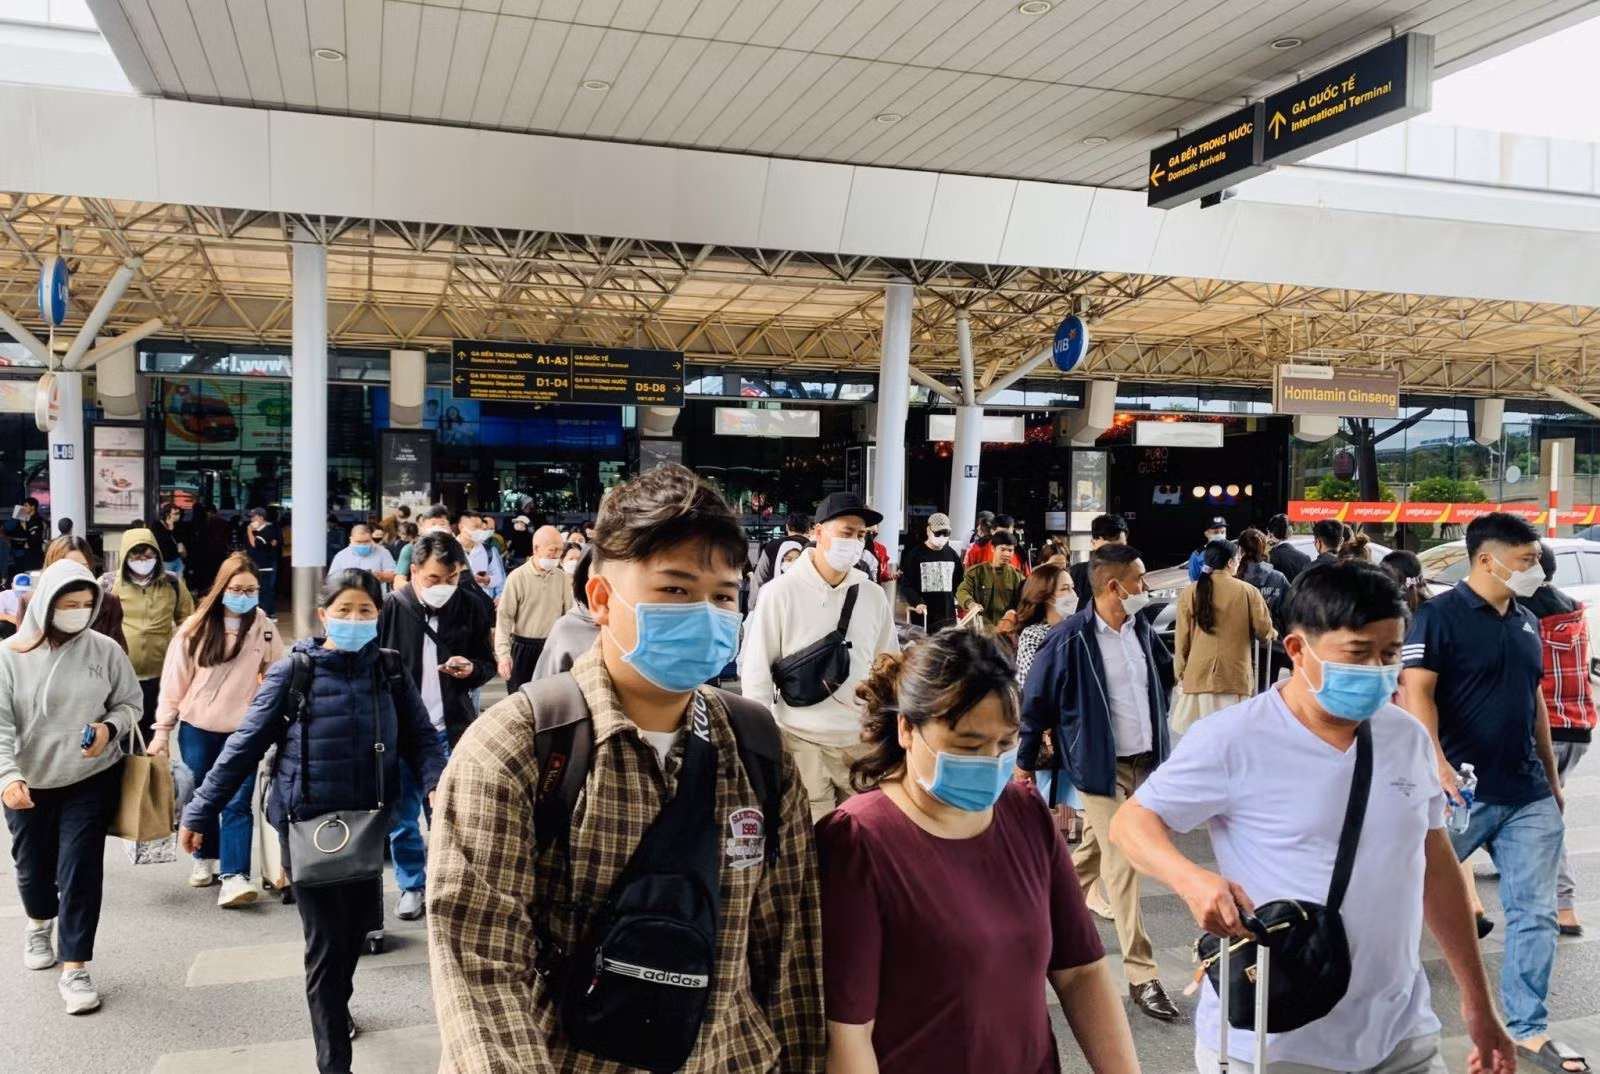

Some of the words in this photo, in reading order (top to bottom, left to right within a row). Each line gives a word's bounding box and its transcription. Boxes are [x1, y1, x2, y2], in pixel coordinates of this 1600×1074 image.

[1292, 100, 1306, 115] GA
[1308, 84, 1339, 107] QUỐC
[1341, 73, 1356, 93] TẾ
[1291, 100, 1347, 132] International
[1349, 81, 1392, 108] Terminal
[1168, 155, 1180, 167] GA
[1199, 135, 1227, 154] TRONG
[1228, 122, 1254, 142] NƯỚC
[1168, 163, 1198, 182] Domestic
[1199, 151, 1226, 169] Arrivals
[1055, 338, 1070, 353] VIB
[537, 355, 568, 365] A1-A3
[536, 377, 568, 387] D1-D4
[635, 383, 666, 392] D5-D8
[1284, 385, 1346, 402] Homtamin
[1348, 389, 1397, 407] Ginseng
[643, 970, 702, 987] adidas
